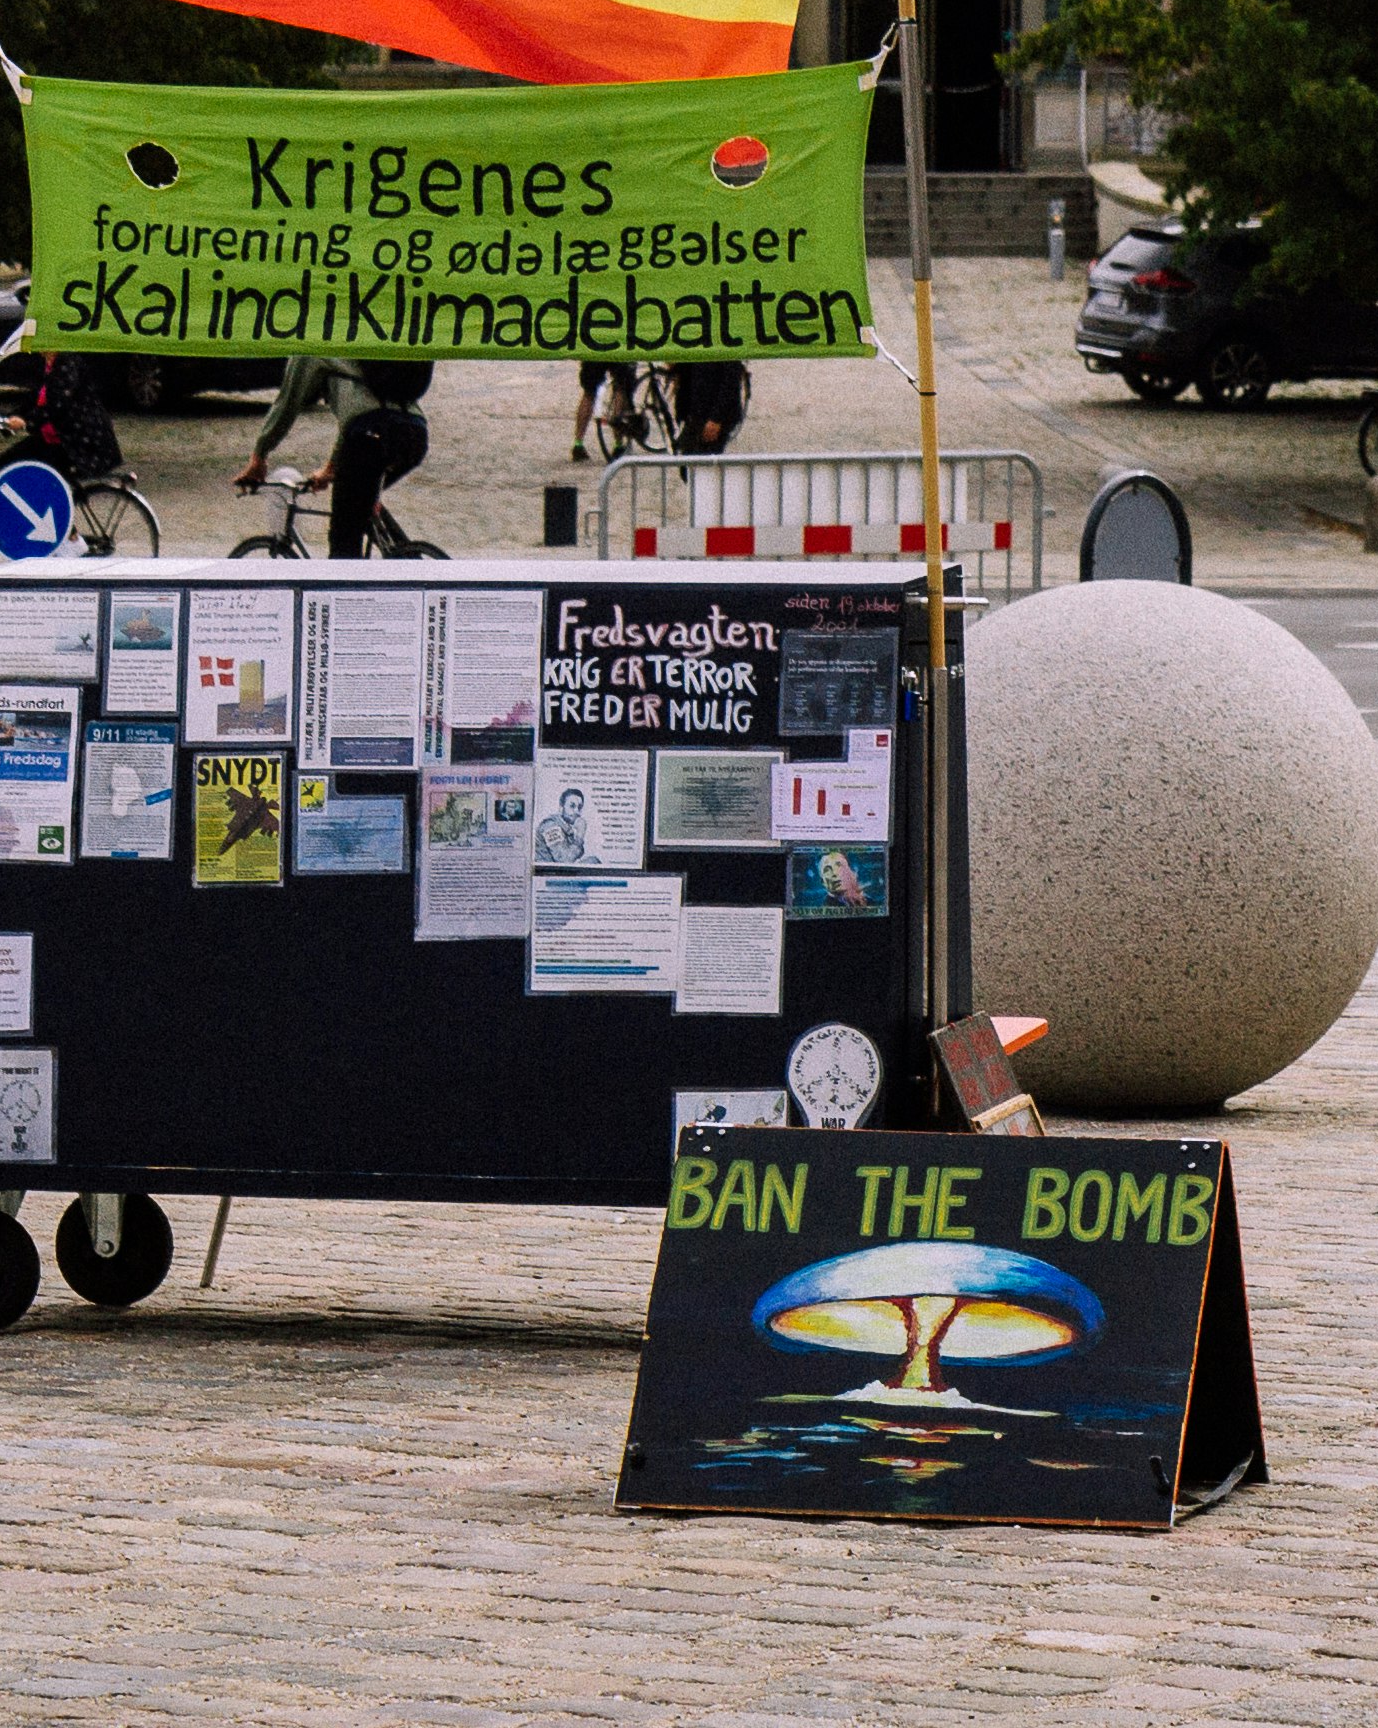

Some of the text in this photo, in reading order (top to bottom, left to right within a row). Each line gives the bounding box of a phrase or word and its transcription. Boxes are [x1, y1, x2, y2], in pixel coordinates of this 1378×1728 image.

[246, 135, 614, 218] Krigenes
[93, 204, 352, 269] forurening
[372, 228, 434, 273] og
[346, 272, 864, 352] Klimadebatten
[785, 592, 830, 611] siden
[558, 599, 778, 657] Fredsvagten
[544, 652, 757, 696] KRIG ER TERROR
[543, 692, 623, 725] FRED
[629, 694, 662, 729] ER
[670, 690, 753, 733] MULIG
[92, 728, 121, 743] 9/11
[3, 752, 62, 769] Fredsdag
[197, 758, 281, 786] SNYDT
[666, 1155, 1217, 1246] BAN THE BOMB
